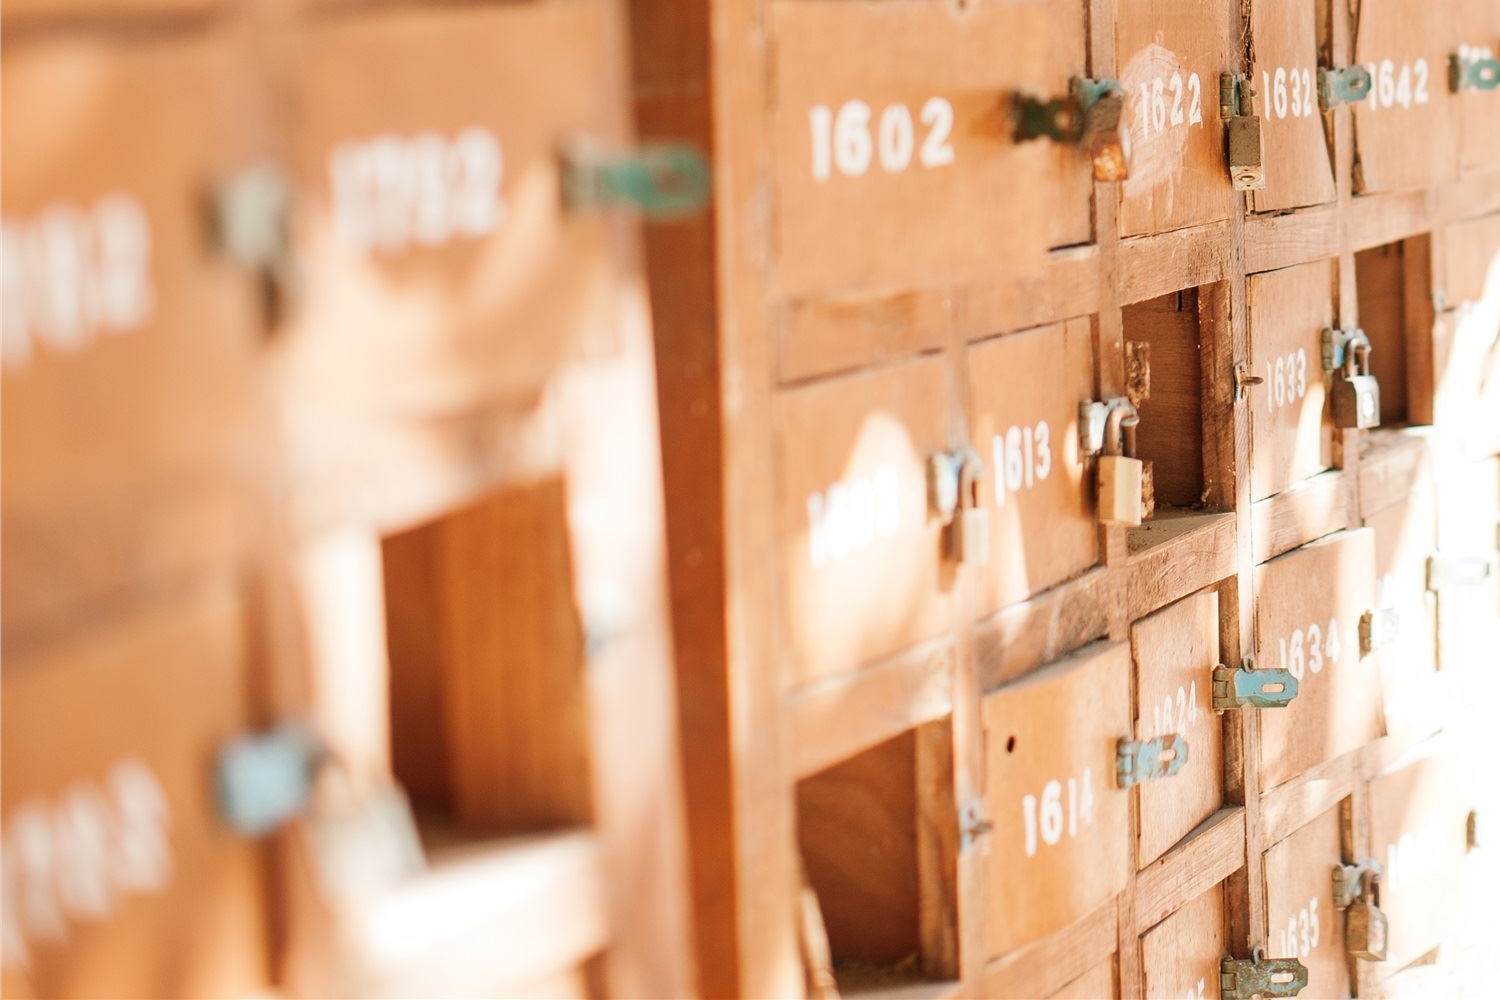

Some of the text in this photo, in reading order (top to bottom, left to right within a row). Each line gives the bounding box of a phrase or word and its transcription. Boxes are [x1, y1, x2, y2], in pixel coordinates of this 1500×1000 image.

[1141, 72, 1203, 140] 1622
[1263, 67, 1311, 120] 1632
[1369, 58, 1428, 111] 1642
[810, 97, 955, 182] 1602
[1267, 347, 1306, 413] 1633
[993, 420, 1050, 508] 1613
[1280, 617, 1340, 681] 1634
[1022, 767, 1093, 856] 1614
